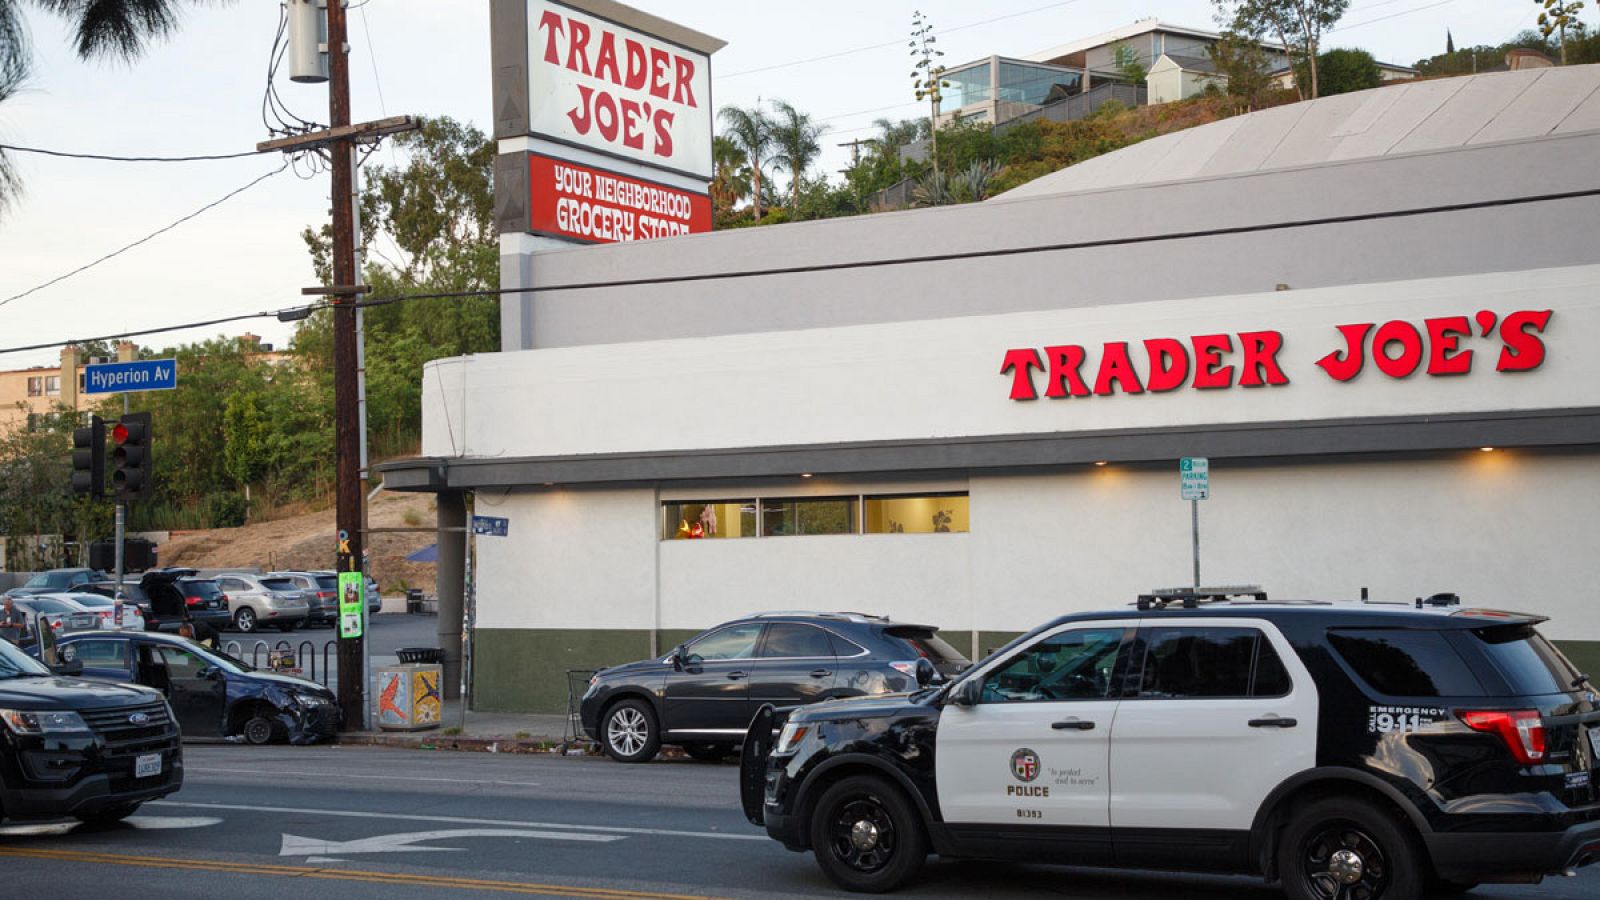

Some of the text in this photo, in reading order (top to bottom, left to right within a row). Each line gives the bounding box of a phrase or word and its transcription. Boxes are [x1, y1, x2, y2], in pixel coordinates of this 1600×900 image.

[539, 10, 698, 108] TRADER
[566, 83, 676, 158] JOE'S
[554, 164, 692, 221] YOUR NEIGHBORHOOD
[556, 197, 634, 241] GROCERY
[91, 366, 170, 388] Hyperion Av
[1000, 309, 1554, 402] TRADER JOE'S
[1183, 460, 1190, 470] 2
[1369, 706, 1446, 716] EMERGENCY
[1007, 785, 1050, 797] POLICE
